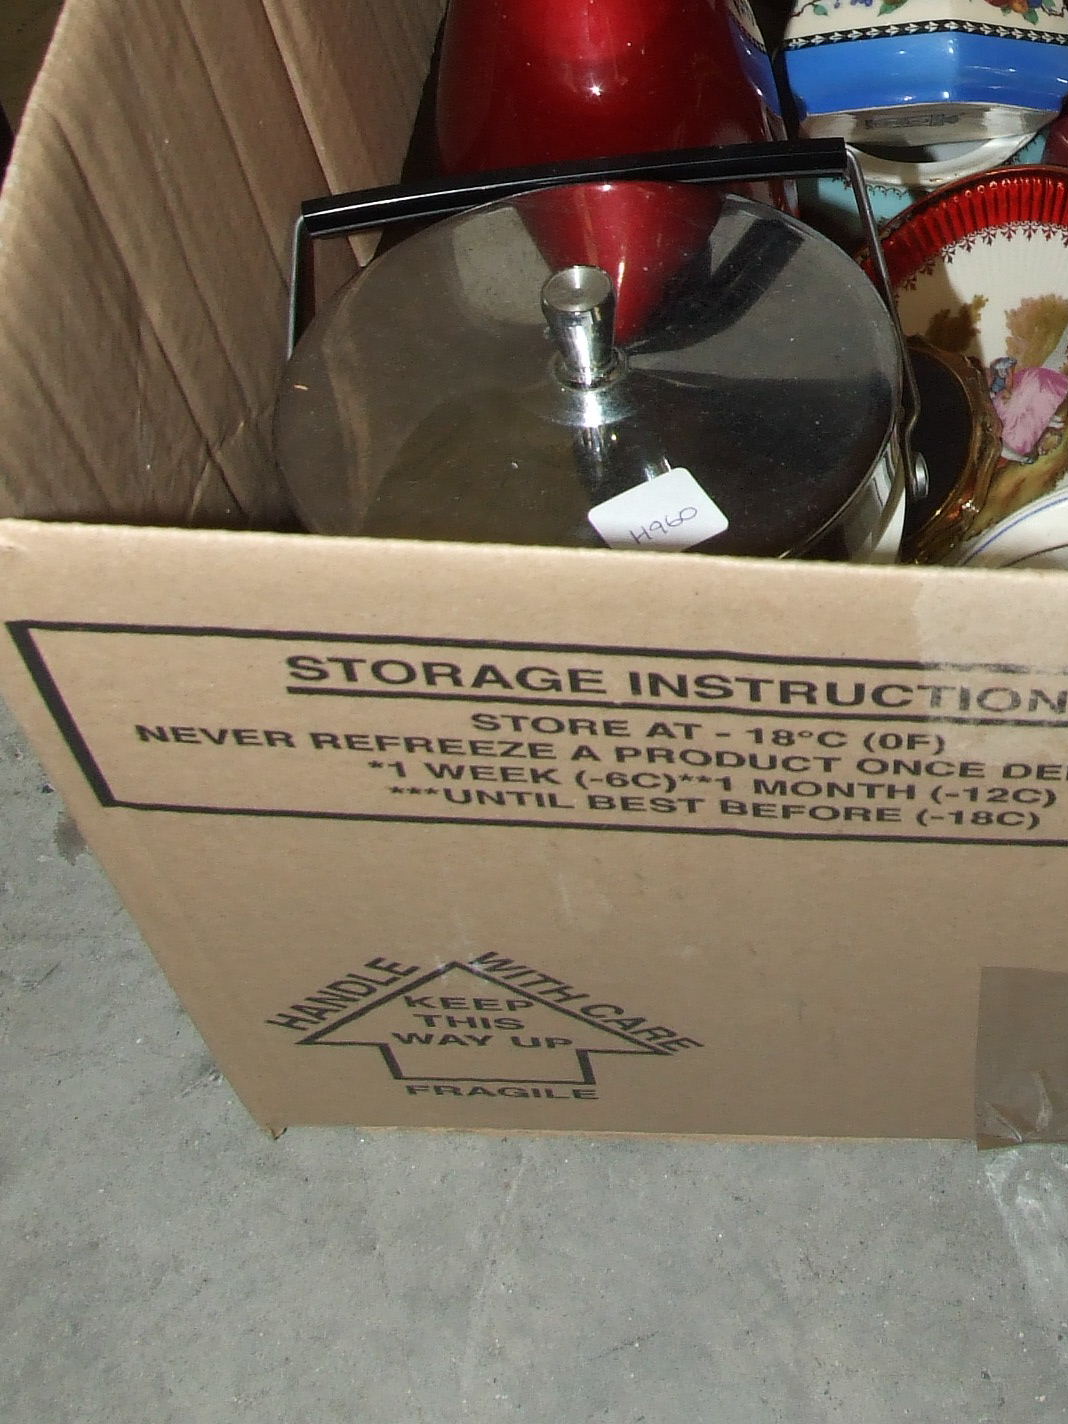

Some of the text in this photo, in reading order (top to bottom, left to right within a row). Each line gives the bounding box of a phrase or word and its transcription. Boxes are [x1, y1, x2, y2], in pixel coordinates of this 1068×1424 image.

[629, 506, 698, 544] H960
[286, 655, 607, 696] STORAGE
[471, 712, 631, 737] STORE
[646, 722, 702, 740] AT
[135, 724, 296, 748] NEVER
[310, 732, 557, 760] REFREEZE
[571, 744, 601, 762] A
[614, 745, 842, 774] PRODUCT
[856, 758, 986, 780] ONCE
[424, 761, 563, 786] WEEK
[753, 778, 916, 801] MONTH
[931, 785, 1057, 809] (-12C)
[588, 794, 706, 815] BEST
[719, 798, 902, 824] BEFORE
[916, 808, 1040, 831] (-18C)
[265, 957, 420, 1030] HANDLE
[404, 995, 534, 1012] KEEP
[468, 950, 706, 1053] WITH CARE
[391, 1031, 574, 1050] WAY UP
[418, 1013, 526, 1031] THIS
[405, 1084, 600, 1100] FRAGILE
